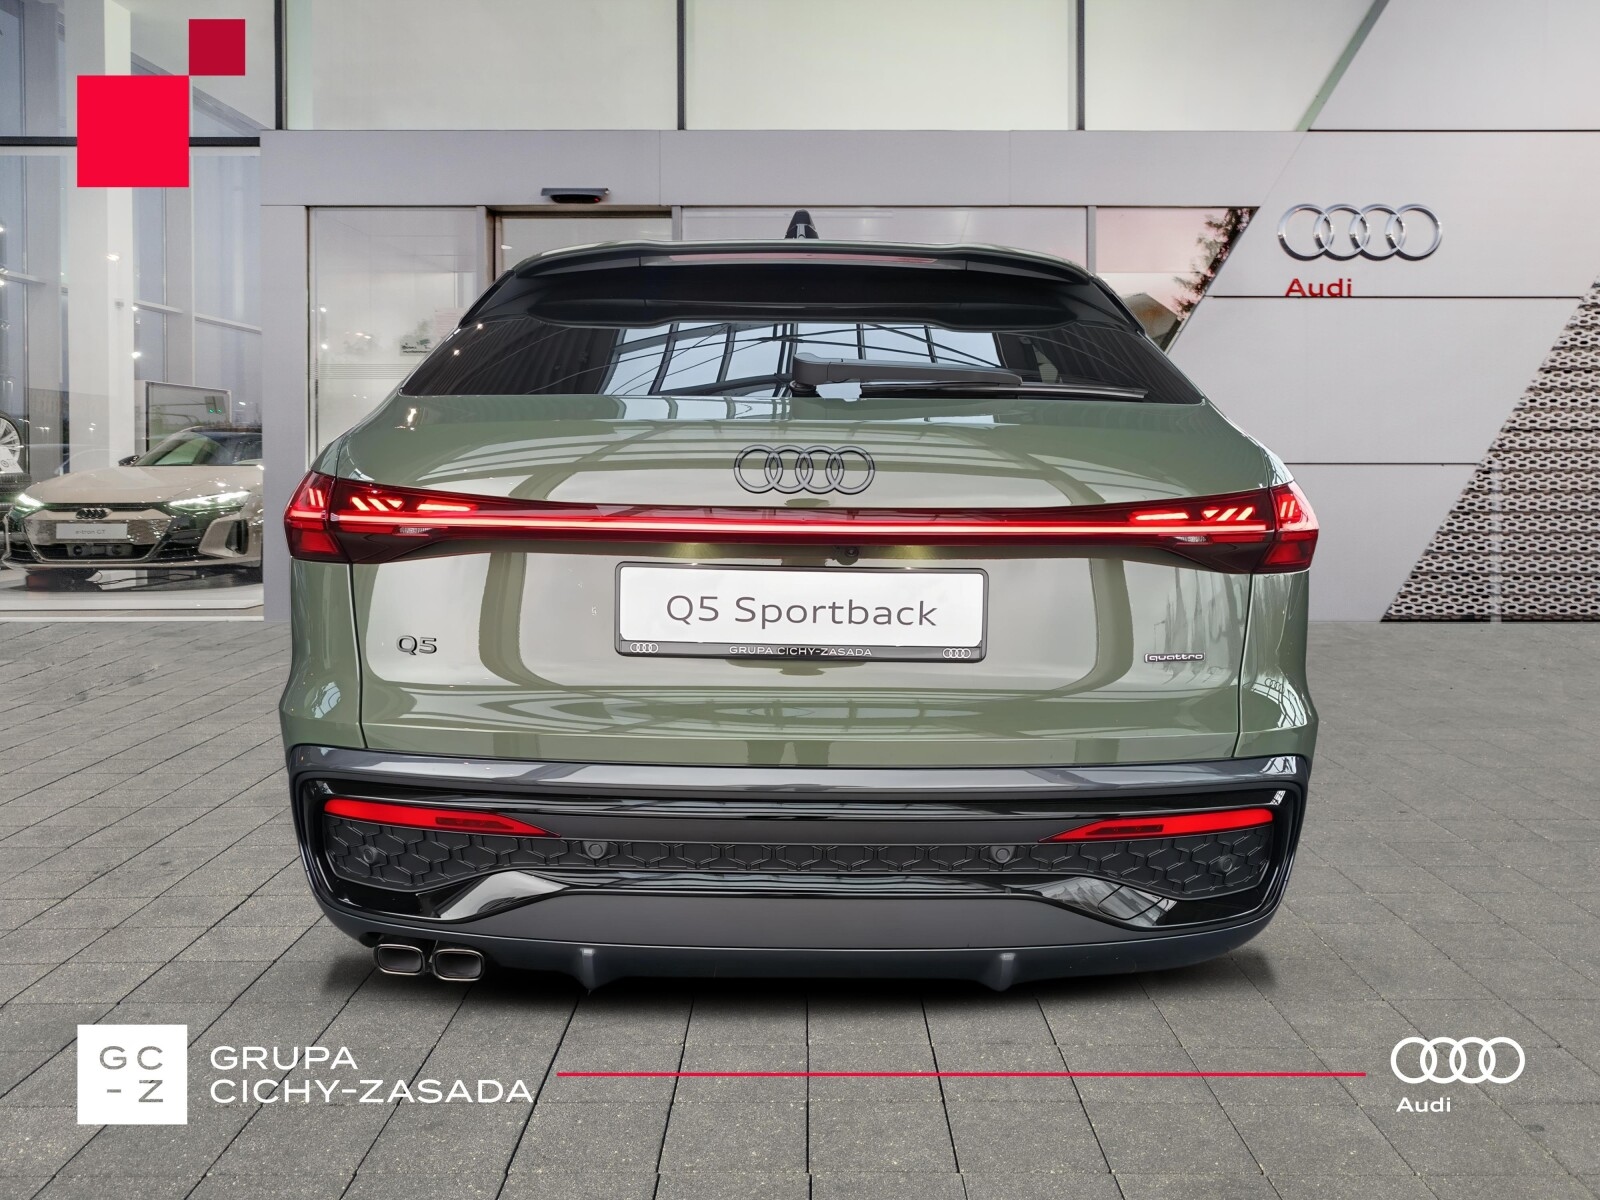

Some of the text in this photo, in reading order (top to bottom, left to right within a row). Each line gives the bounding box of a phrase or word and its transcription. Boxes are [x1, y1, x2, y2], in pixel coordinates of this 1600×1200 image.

[1285, 278, 1352, 298] Audi
[666, 595, 938, 630] Q5 Sportback
[396, 635, 438, 656] Q5
[729, 645, 873, 657] GRUPA CICHY-ZASADA
[1147, 653, 1205, 662] quattro
